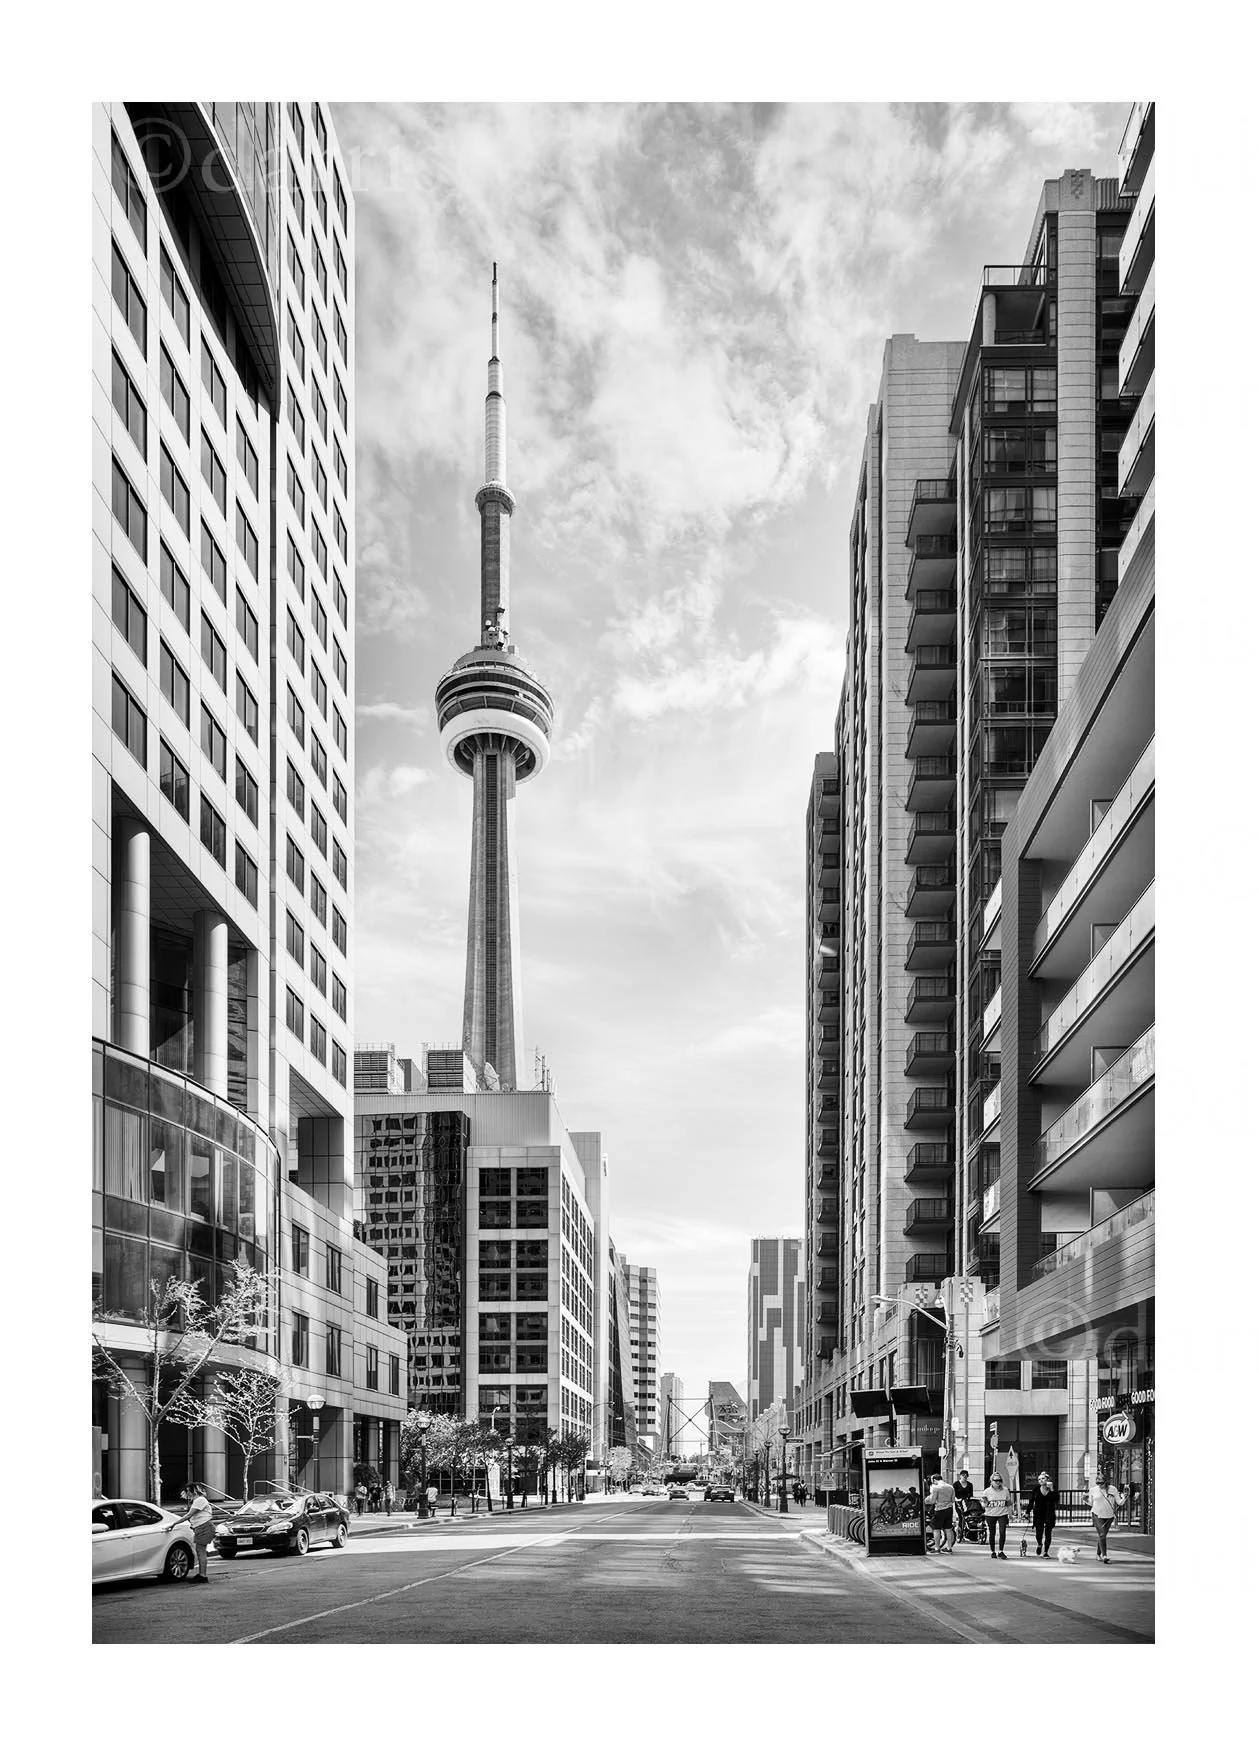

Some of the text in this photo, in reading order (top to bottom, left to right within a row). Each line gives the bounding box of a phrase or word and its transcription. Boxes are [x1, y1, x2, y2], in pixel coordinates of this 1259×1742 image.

[1102, 1396, 1115, 1409] FOOD
[1131, 1388, 1155, 1404] GOOD FO
[1107, 1423, 1128, 1438] A&W
